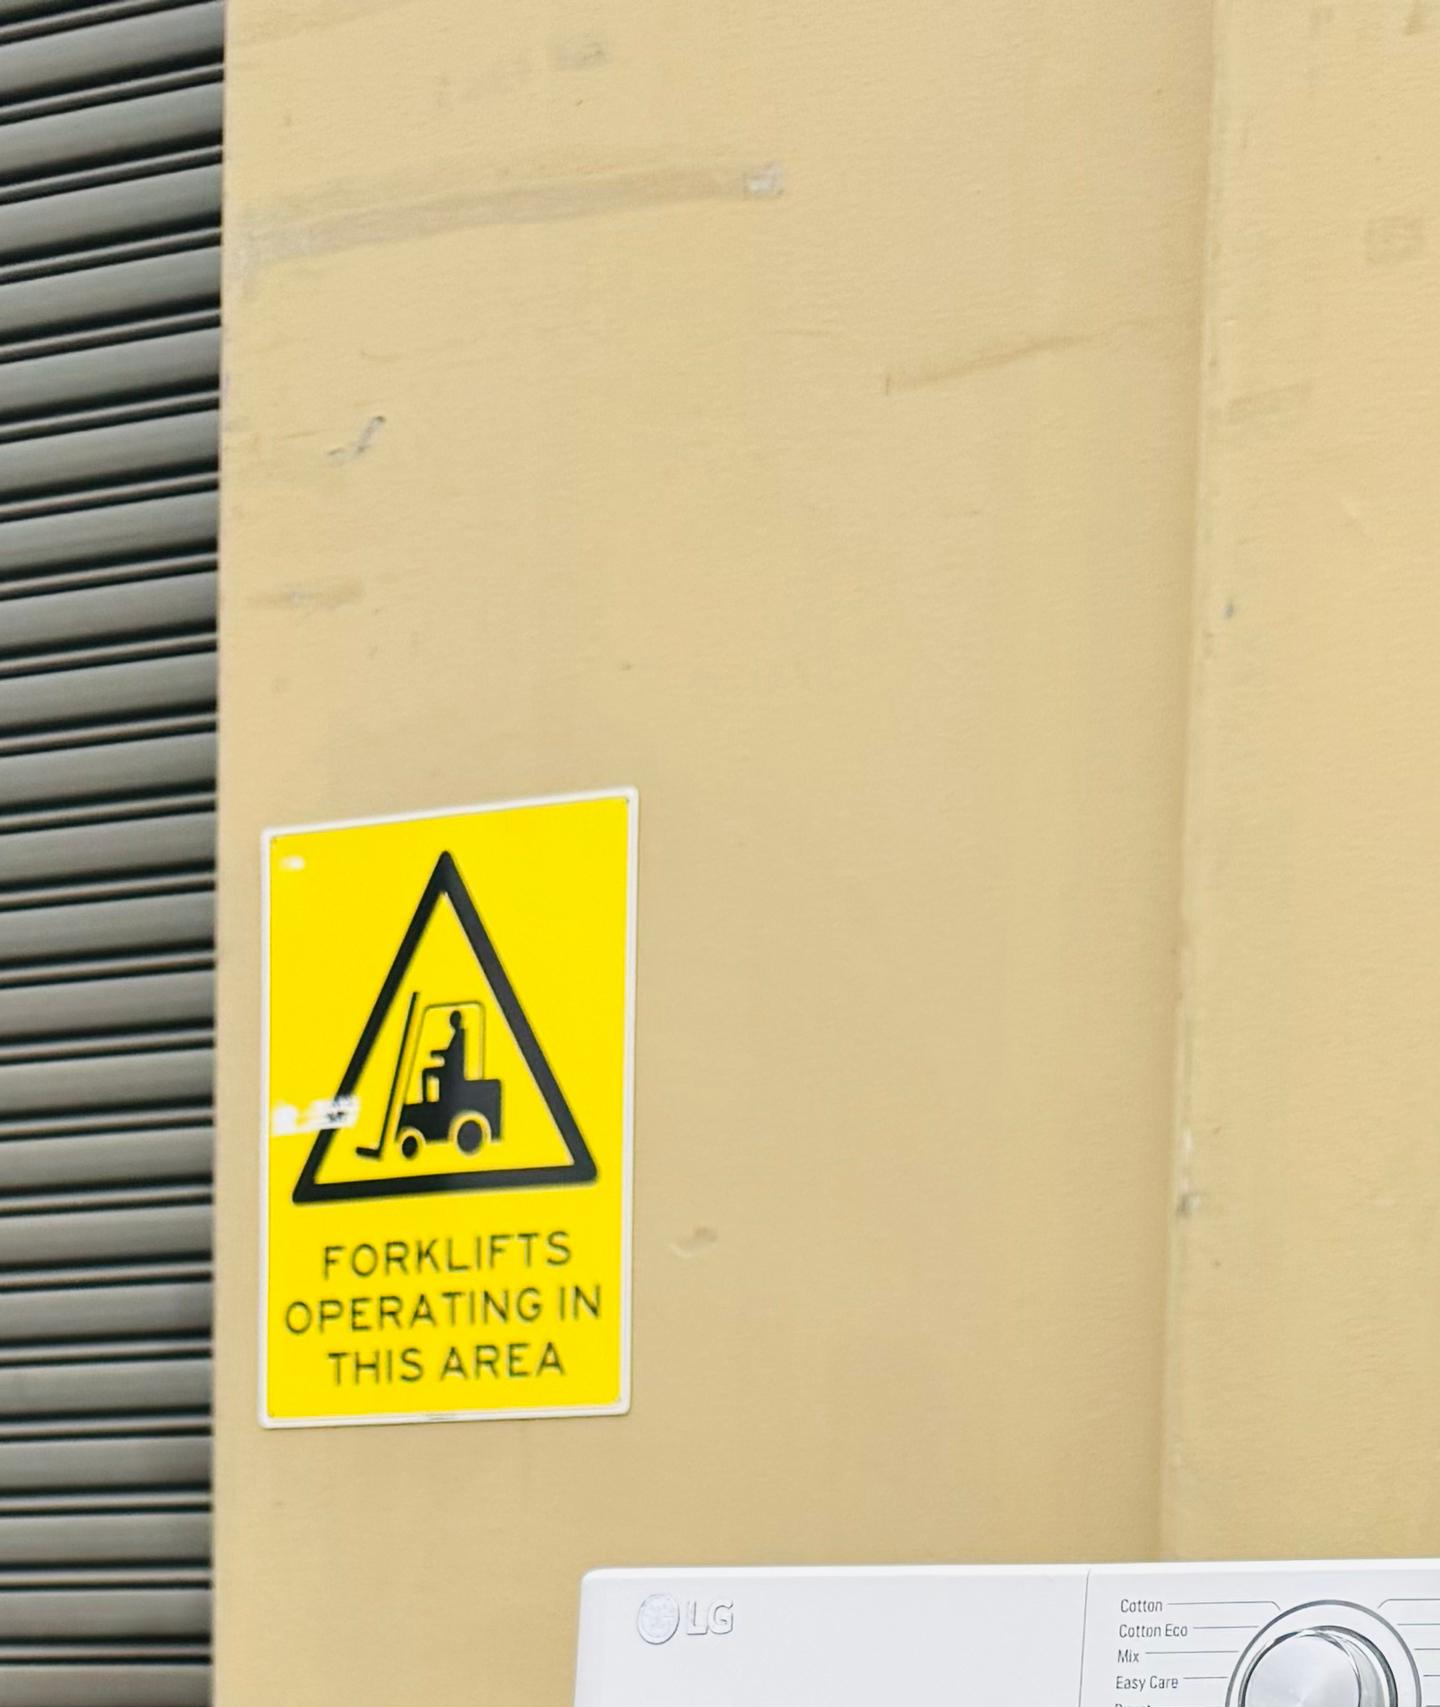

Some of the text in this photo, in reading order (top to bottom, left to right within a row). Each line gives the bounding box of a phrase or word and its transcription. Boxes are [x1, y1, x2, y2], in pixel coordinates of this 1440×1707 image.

[323, 1231, 572, 1280] FORKLIFTS
[285, 1285, 602, 1337] OPERATING IN
[328, 1341, 567, 1387] THIS AREA
[685, 1599, 734, 1636] LG
[1120, 1599, 1163, 1613] Cotton
[1119, 1624, 1188, 1638] Cotton Eco
[1117, 1649, 1140, 1664] Mix
[1115, 1675, 1179, 1692] Easy Care
